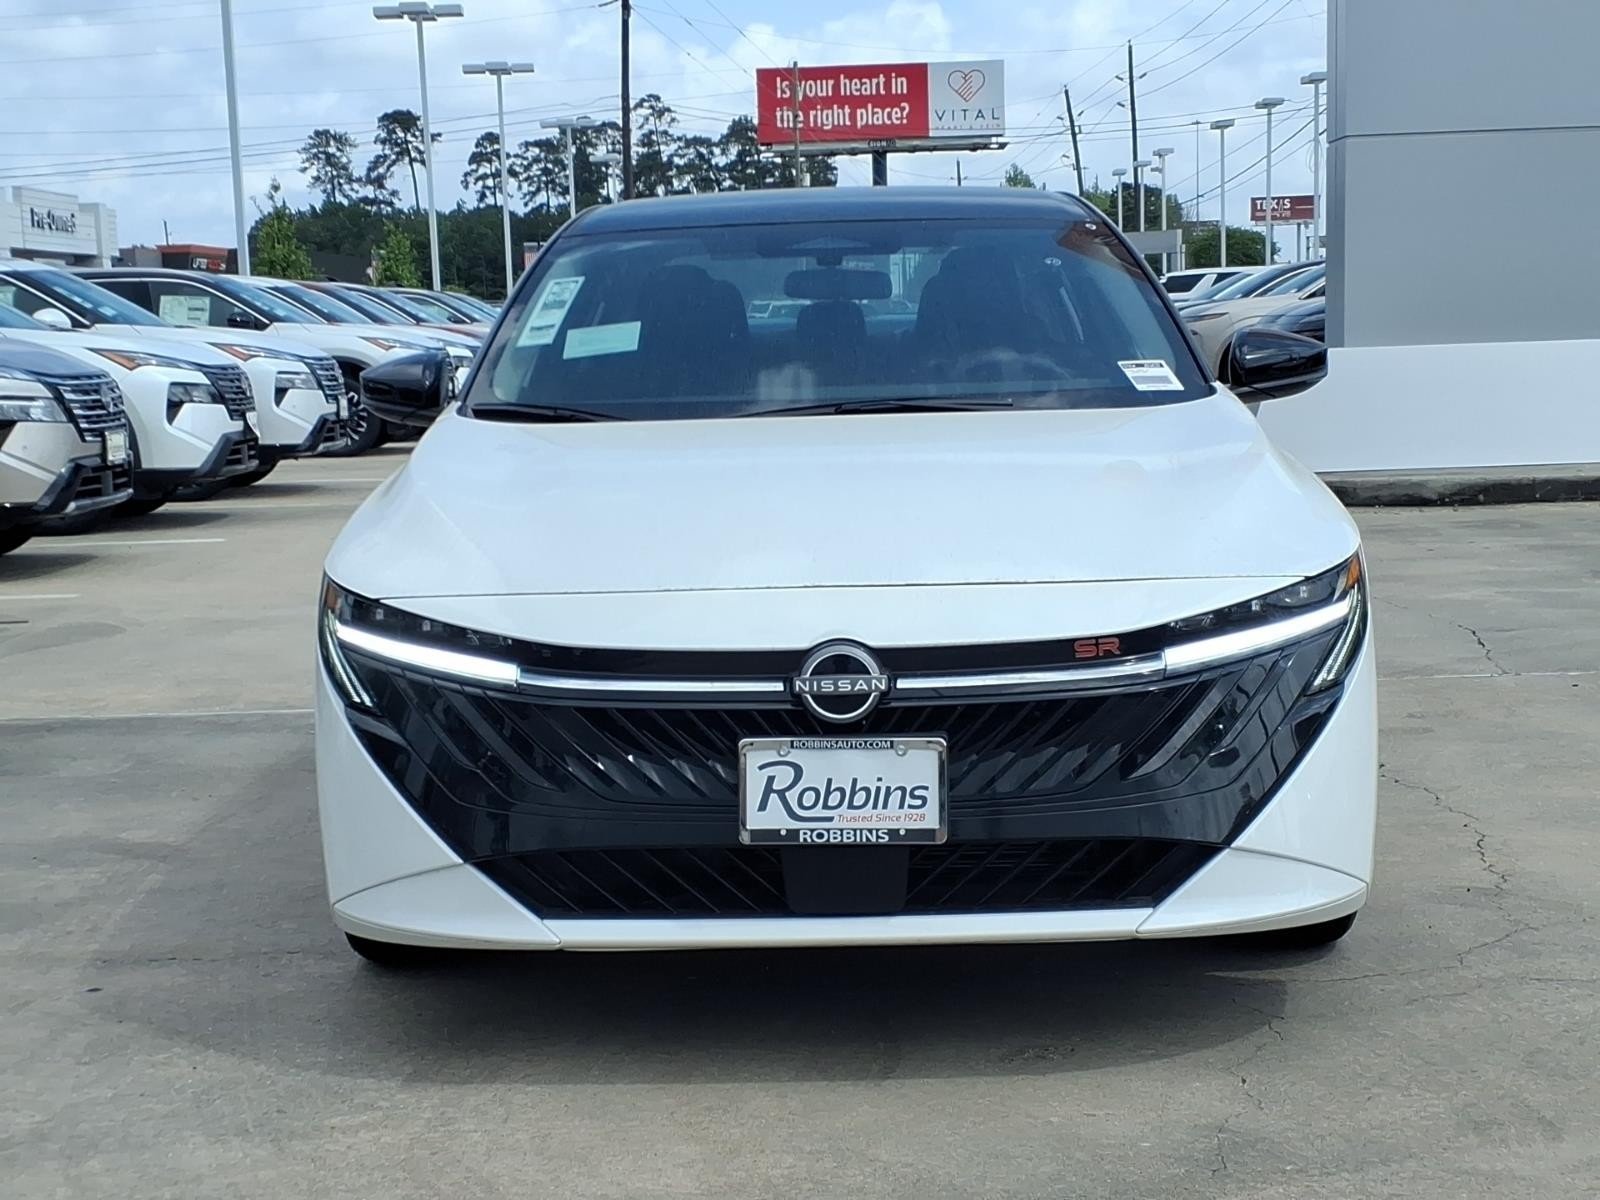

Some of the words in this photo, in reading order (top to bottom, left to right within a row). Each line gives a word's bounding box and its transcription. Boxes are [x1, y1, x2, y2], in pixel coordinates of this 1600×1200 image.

[776, 76, 791, 99] Is
[797, 79, 834, 101] your
[840, 73, 886, 97] heart
[891, 72, 907, 94] in
[776, 106, 804, 128] the
[809, 104, 851, 130] right
[856, 102, 910, 129] place?
[934, 107, 1000, 121] VITAL
[1073, 637, 1121, 658] SR
[794, 678, 888, 693] NISSAN
[793, 740, 891, 750] ROBBINSAUTO.COM
[756, 760, 930, 823] Robbins
[836, 814, 873, 824] Trusted
[875, 813, 901, 823] Since
[903, 813, 926, 822] 1928
[799, 829, 890, 843] ROBBINS
